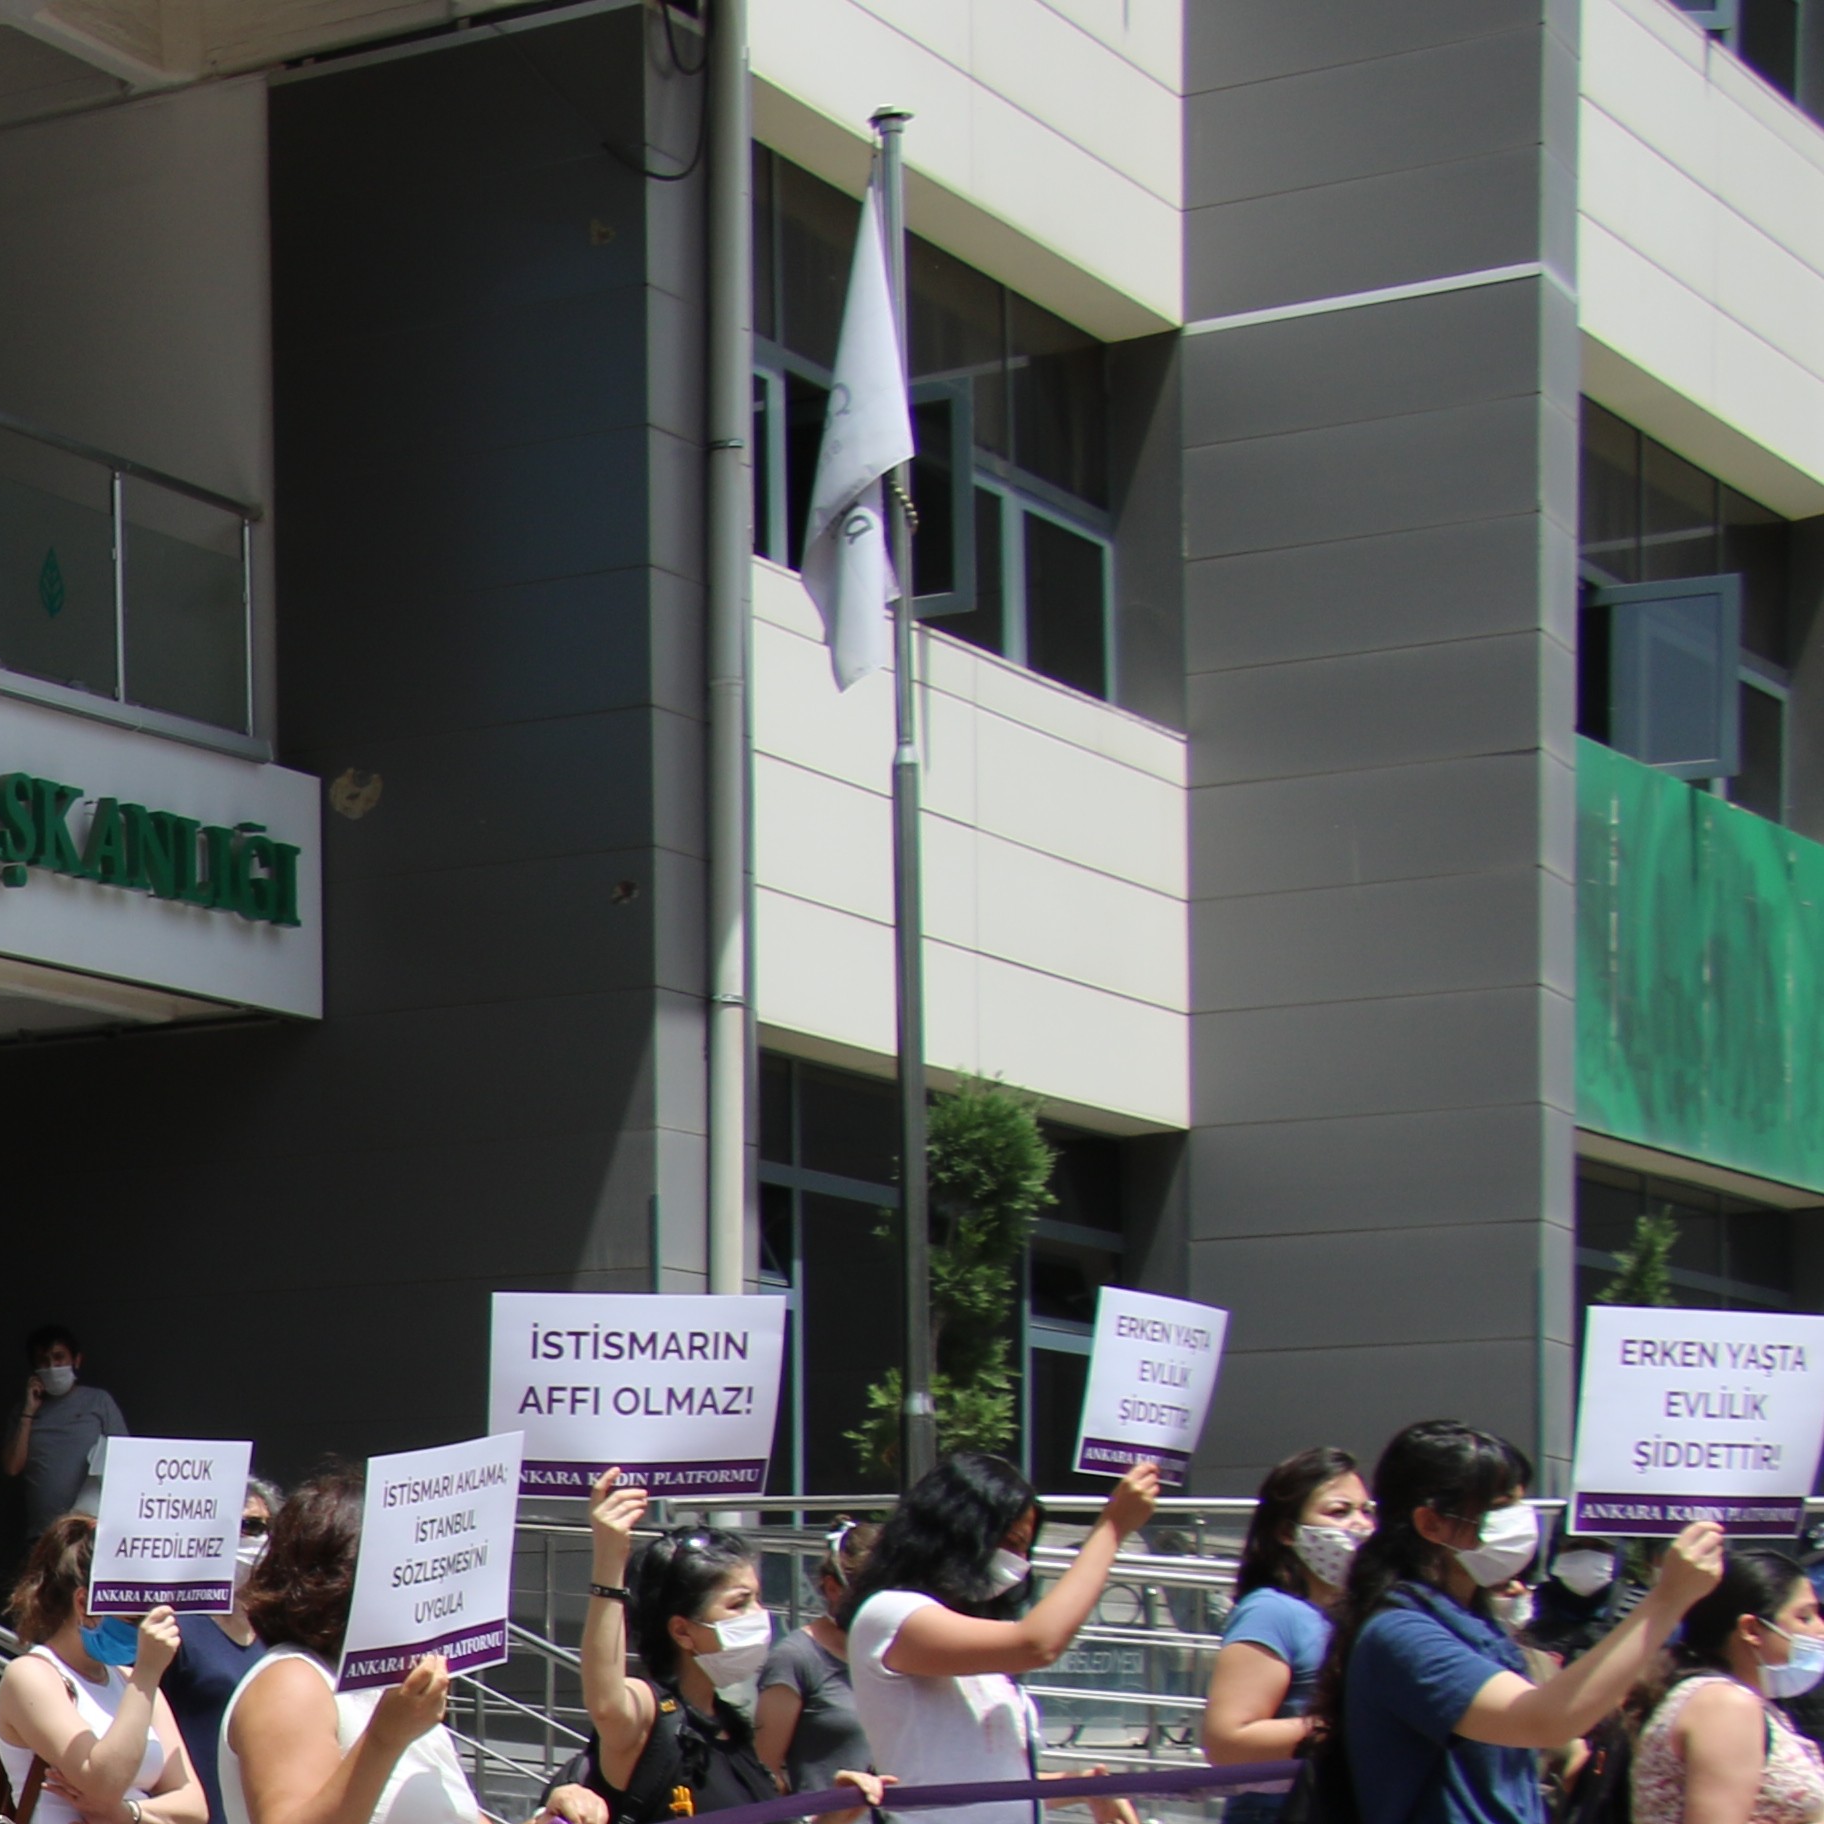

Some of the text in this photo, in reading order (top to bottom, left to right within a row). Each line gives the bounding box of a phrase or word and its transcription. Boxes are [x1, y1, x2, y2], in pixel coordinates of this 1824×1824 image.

[530, 1322, 750, 1361] İSTİSMARIN
[1117, 1314, 1173, 1344] ERKEN
[1620, 1338, 1807, 1378] ERKEN YAŞTA
[518, 1385, 755, 1417] AFFI OLMAZ!
[1664, 1385, 1769, 1420] EVLİLİK
[1083, 1447, 1134, 1465] ANKARA
[1632, 1433, 1784, 1474] ŞİDDETTİR!
[155, 1458, 213, 1485] ÇOCUK
[587, 1471, 650, 1488] KDIN
[653, 1468, 760, 1485] PLATFORMU
[138, 1492, 218, 1520] İSTİSMARI
[383, 1473, 454, 1509] İSTİSMARI
[414, 1509, 477, 1544] İSTANBUL
[1580, 1503, 1663, 1521] ANKARA
[115, 1532, 225, 1559] AFFEDİLEMEZ
[94, 1588, 141, 1603] ANKARA
[414, 1591, 465, 1624] UYGULA
[442, 1629, 504, 1660] PLATFORMU
[345, 1656, 405, 1679] ANKARA
